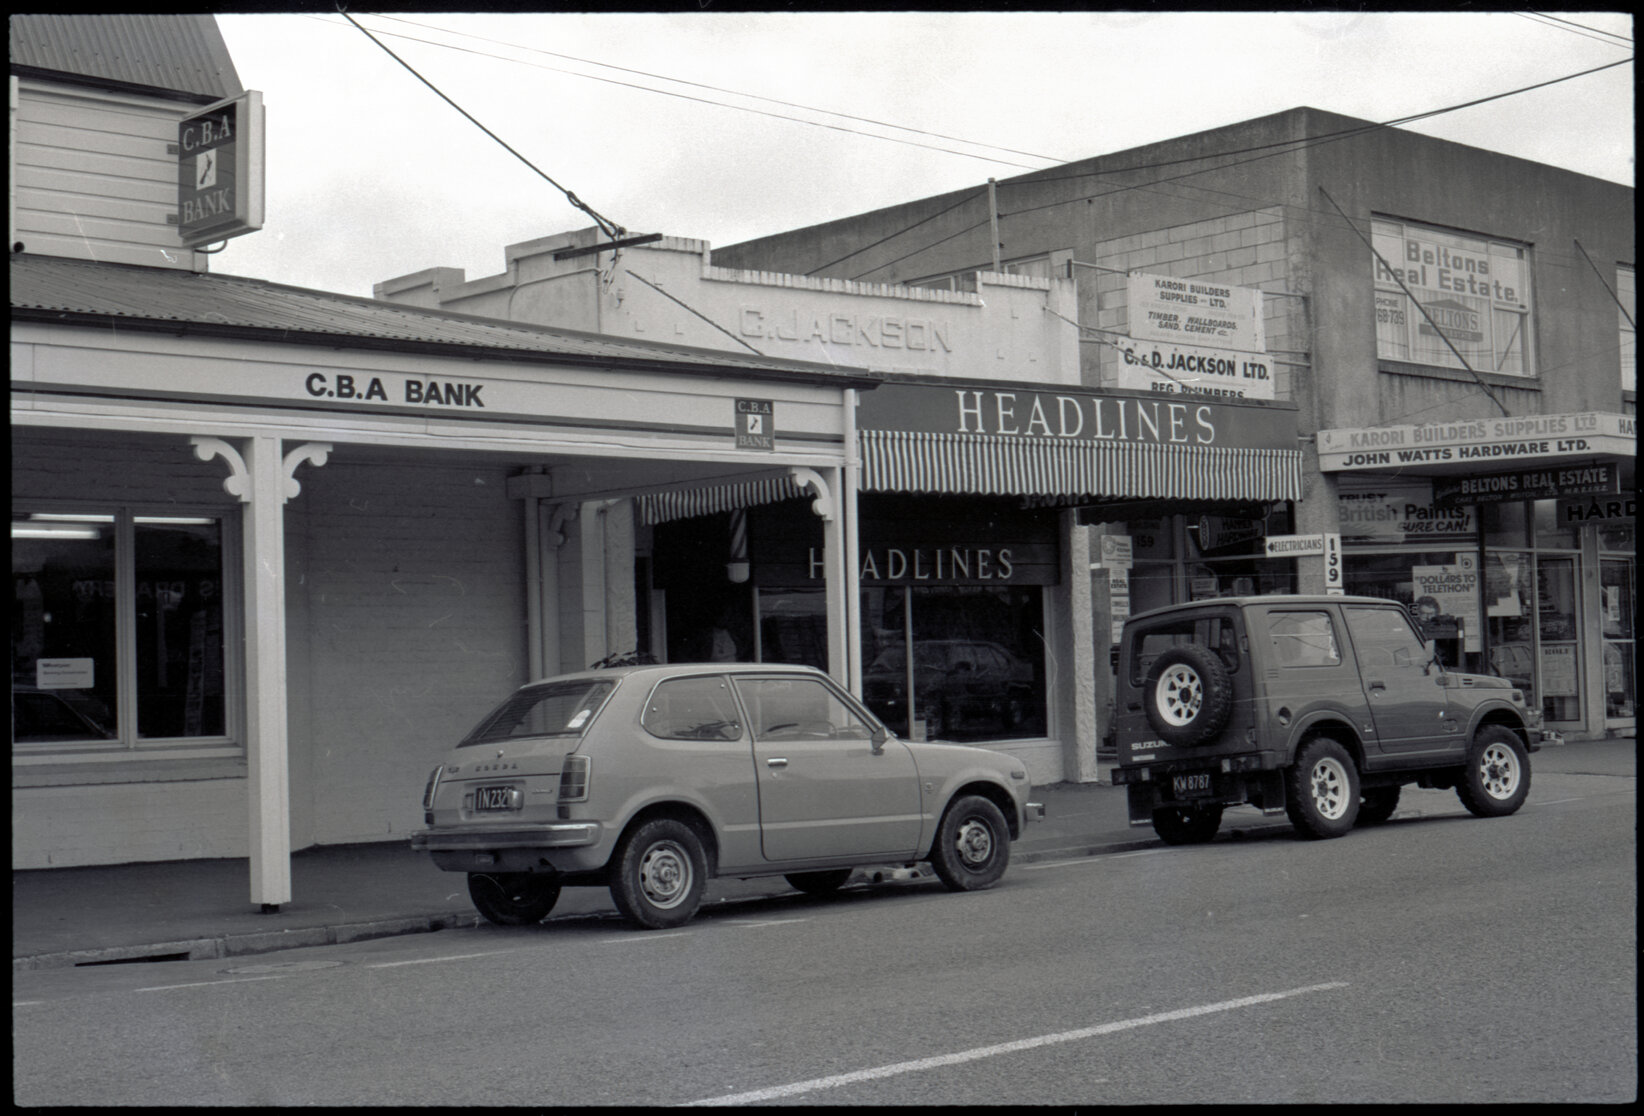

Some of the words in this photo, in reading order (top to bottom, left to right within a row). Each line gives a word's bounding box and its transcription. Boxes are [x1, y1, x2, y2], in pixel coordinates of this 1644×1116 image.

[183, 115, 231, 151] C.B.A
[183, 187, 231, 225] BANK
[1406, 239, 1489, 276] Beltons
[1376, 259, 1427, 286] Real
[1155, 279, 1187, 292] KARORI
[1190, 284, 1231, 299] BUILDERS
[1160, 291, 1198, 305] SUPPLIES
[1184, 324, 1216, 335] CEMENT
[1167, 353, 1236, 377] JACKSON
[1243, 361, 1270, 381] LTD.
[305, 372, 388, 401] C.B.A
[405, 379, 485, 408] BANK
[955, 390, 1216, 445] HEADLINES
[738, 435, 771, 448] BANK
[1350, 429, 1405, 447] KARORI
[1495, 418, 1568, 437] SUPPLIES
[1343, 453, 1390, 467] JOHN
[1397, 448, 1453, 463] WATTS
[1459, 441, 1550, 458] HARDWARE
[1557, 439, 1592, 452] LTD.
[1461, 475, 1518, 495] BELTONS
[1523, 471, 1556, 489] REAL
[1559, 467, 1608, 486] ESTATE
[1338, 504, 1398, 522] British
[1405, 504, 1464, 520] Paints
[1274, 538, 1322, 552] ELECTRICIANS
[809, 548, 1013, 579] HADLINES
[1328, 538, 1339, 582] 159
[1464, 574, 1476, 583] TO
